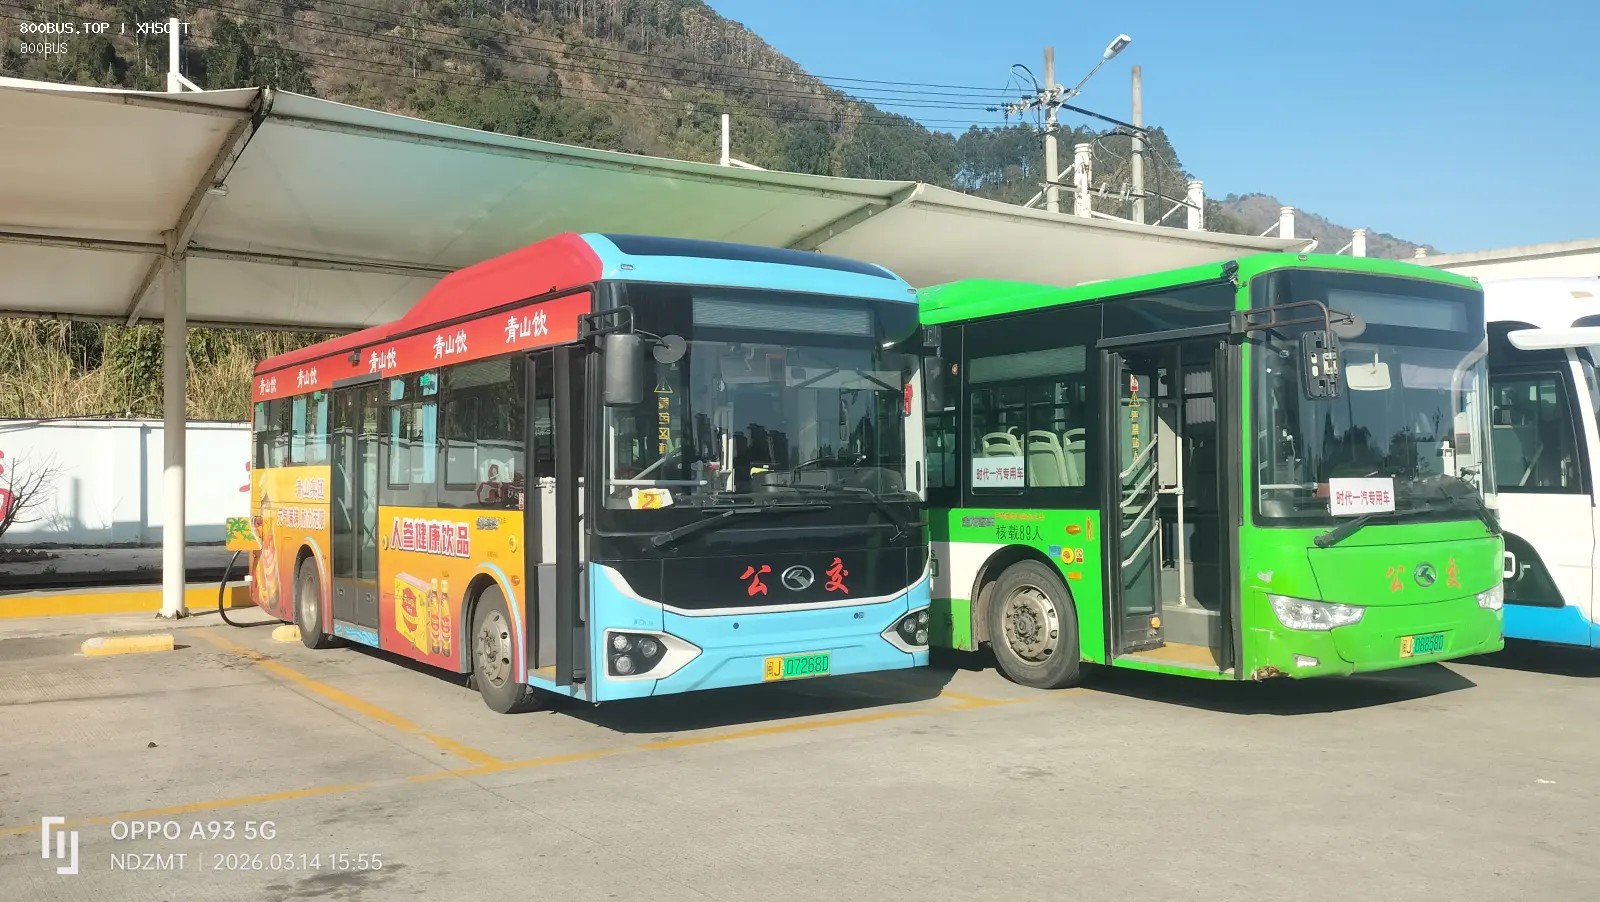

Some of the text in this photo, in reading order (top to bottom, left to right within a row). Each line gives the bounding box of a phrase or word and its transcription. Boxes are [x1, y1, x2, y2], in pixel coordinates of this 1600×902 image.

[504, 308, 549, 344] 青山饮
[432, 328, 468, 360] 青山饮
[368, 346, 397, 374] 青山饮
[975, 466, 1024, 482] 时代一汽专用车
[1335, 489, 1391, 507] 时代一汽专用车
[995, 524, 1044, 542] 核载89人
[739, 556, 850, 597] 公 交
[1385, 556, 1463, 593] 公 交
